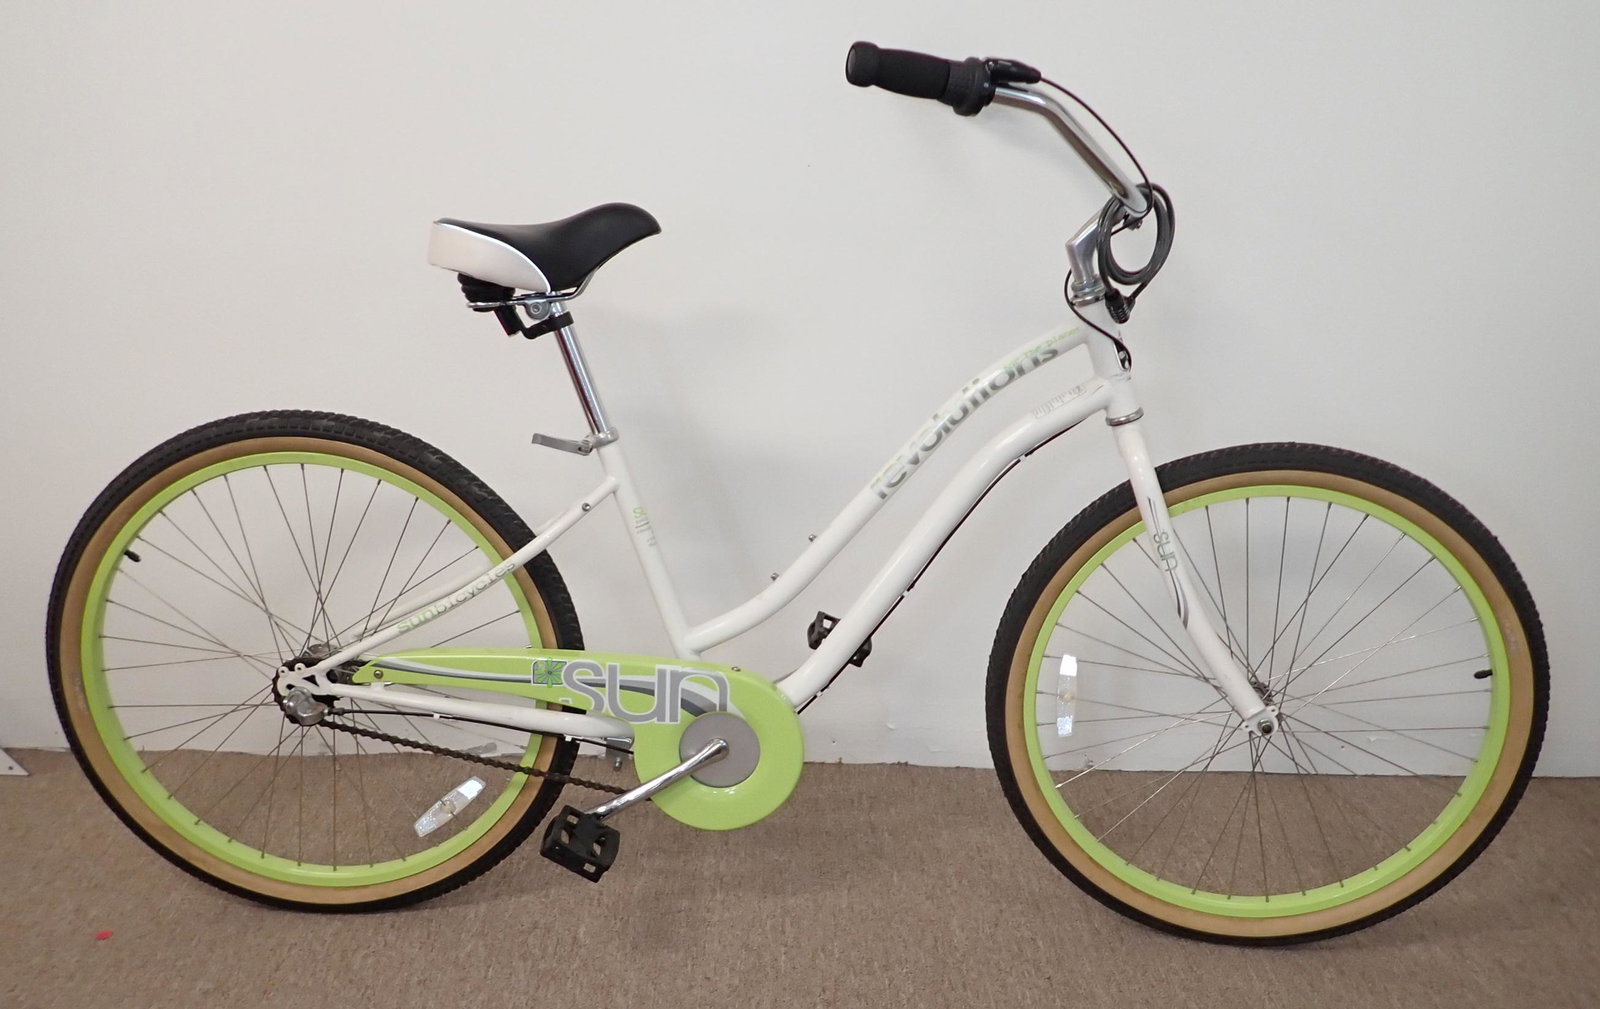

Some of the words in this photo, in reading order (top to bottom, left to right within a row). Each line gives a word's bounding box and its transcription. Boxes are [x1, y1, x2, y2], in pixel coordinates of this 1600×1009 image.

[870, 347, 1060, 500] revolutions
[1153, 531, 1178, 572] sun
[397, 562, 516, 634] sunbicycles
[559, 659, 730, 724] sun
